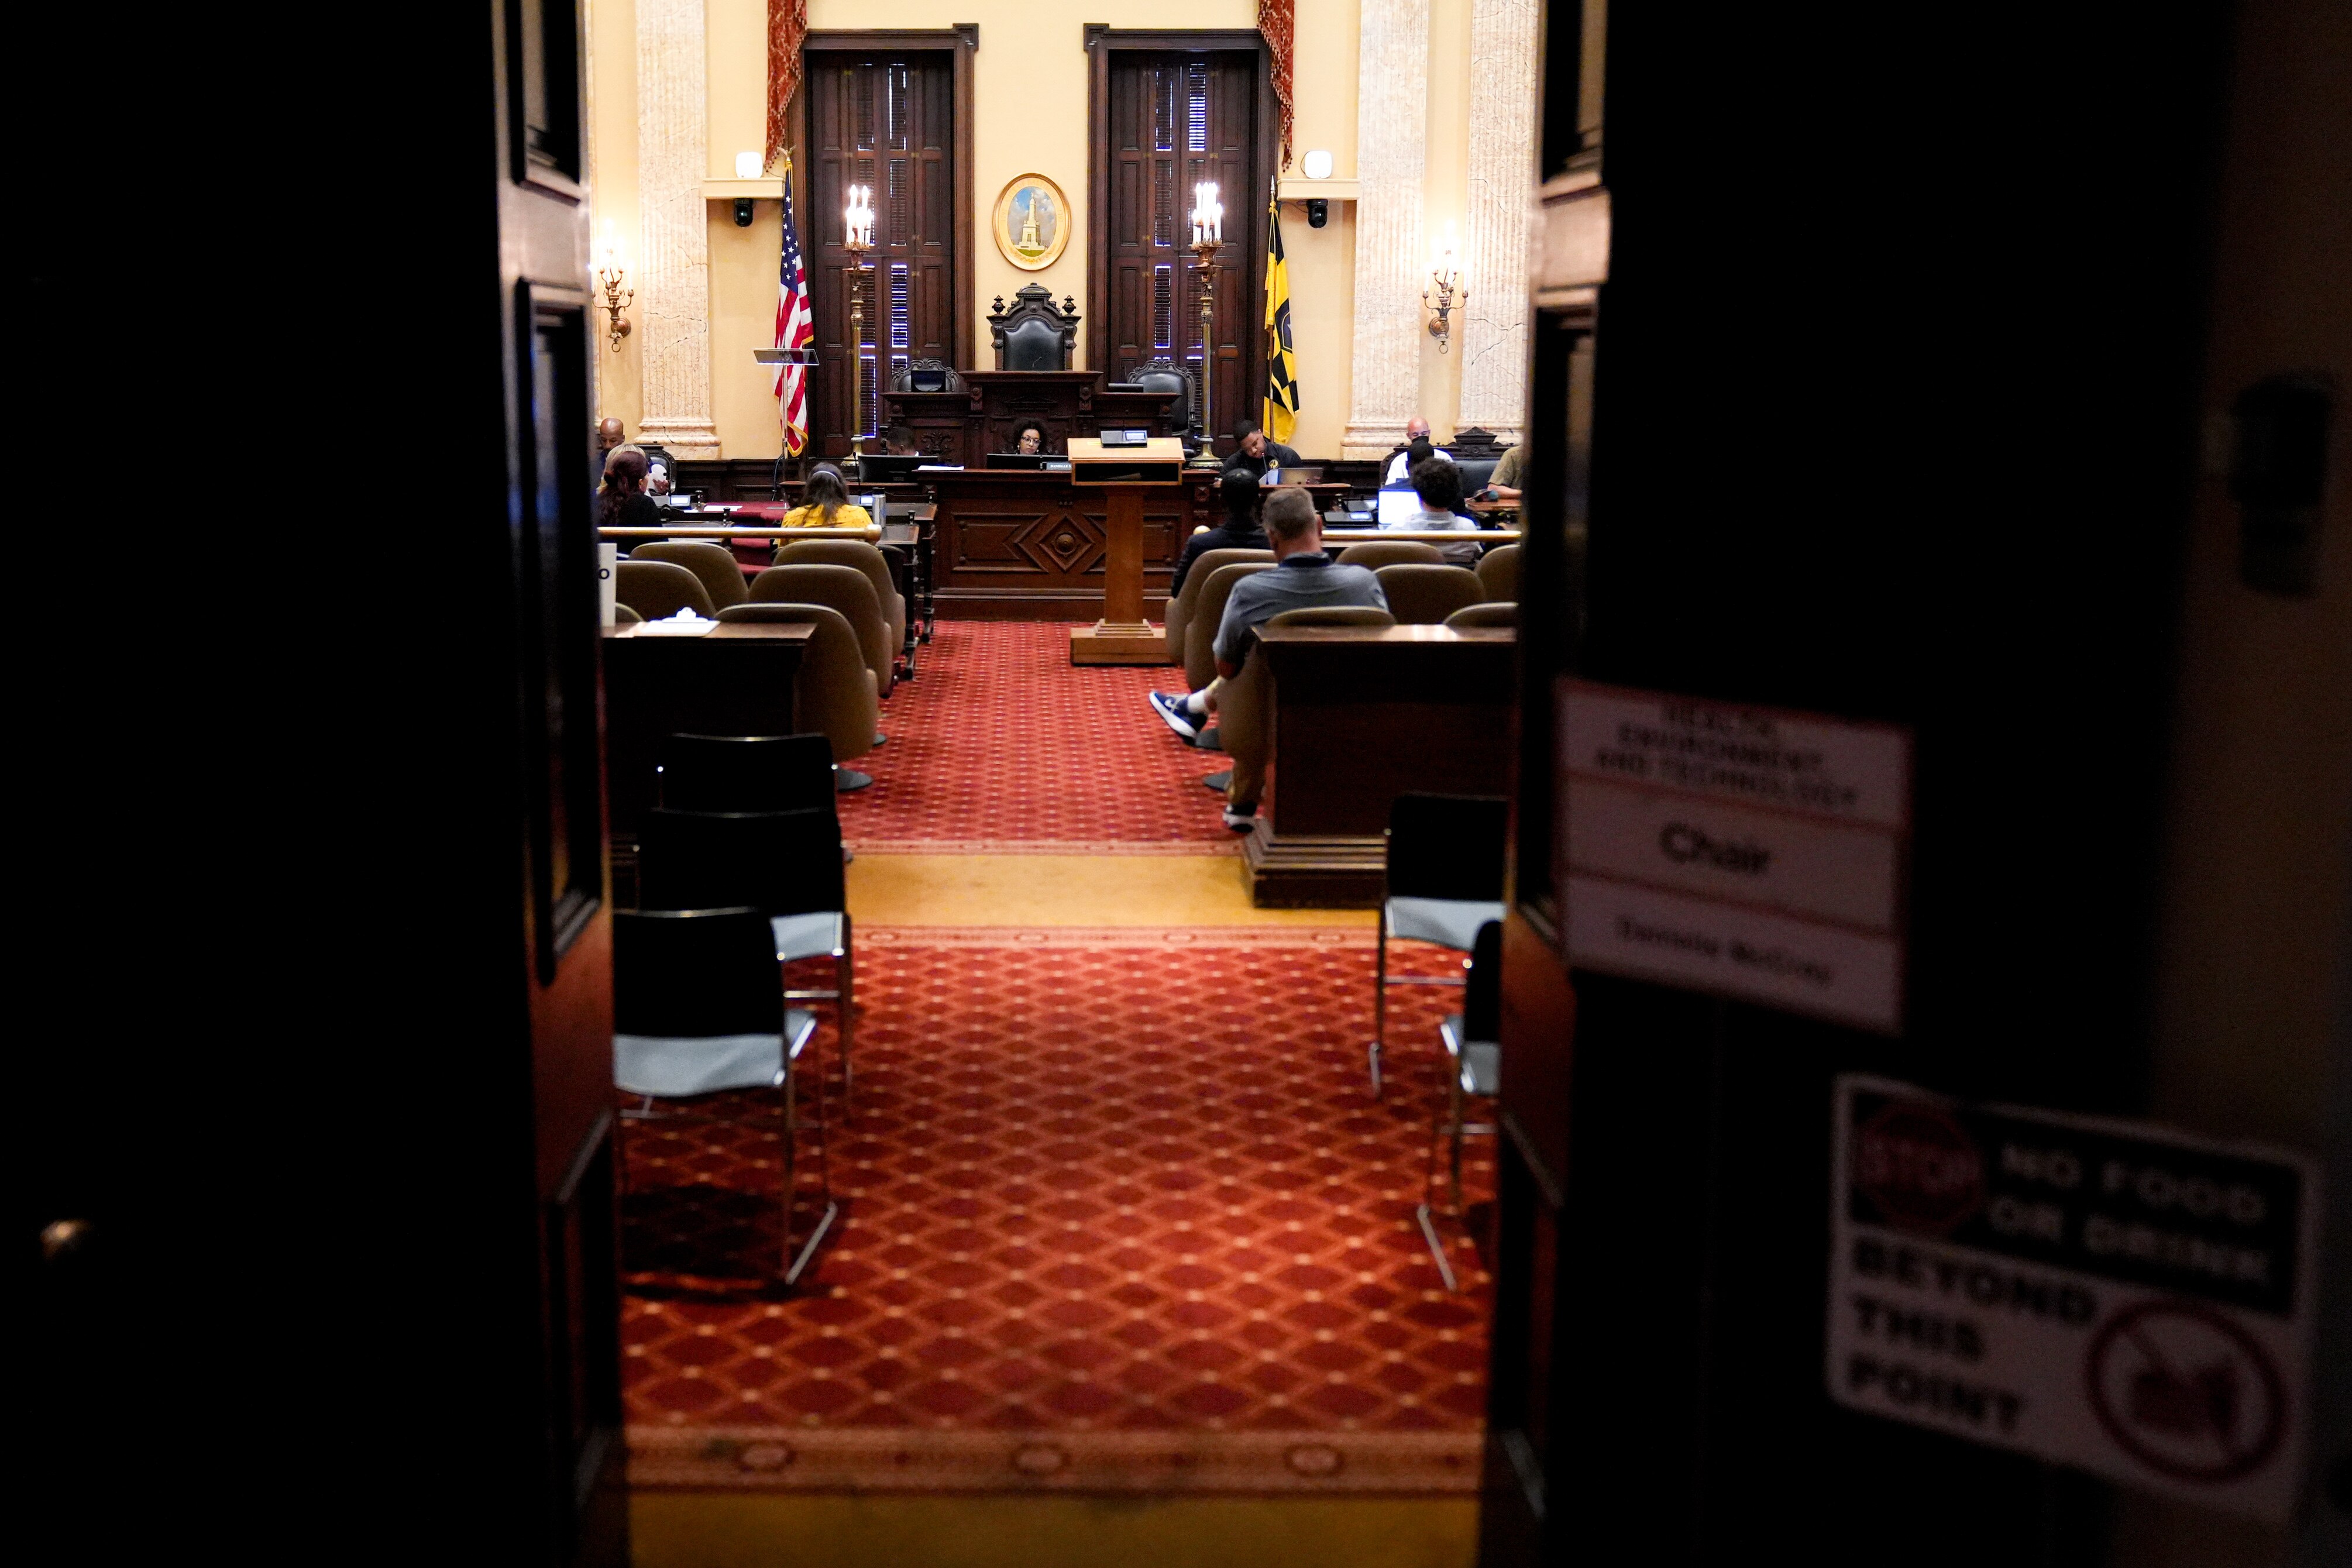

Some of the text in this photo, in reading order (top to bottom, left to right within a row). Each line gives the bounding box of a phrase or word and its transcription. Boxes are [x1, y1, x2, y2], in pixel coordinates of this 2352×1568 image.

[1659, 821, 1772, 876] Chair
[1858, 1136, 1982, 1196] STOP
[1997, 1140, 2269, 1227] NO FOOD
[1986, 1194, 2272, 1290] OR DRINK
[1852, 1238, 2096, 1326] BEYOND
[1852, 1293, 1984, 1362] THIS
[1847, 1357, 2024, 1432] POINT
